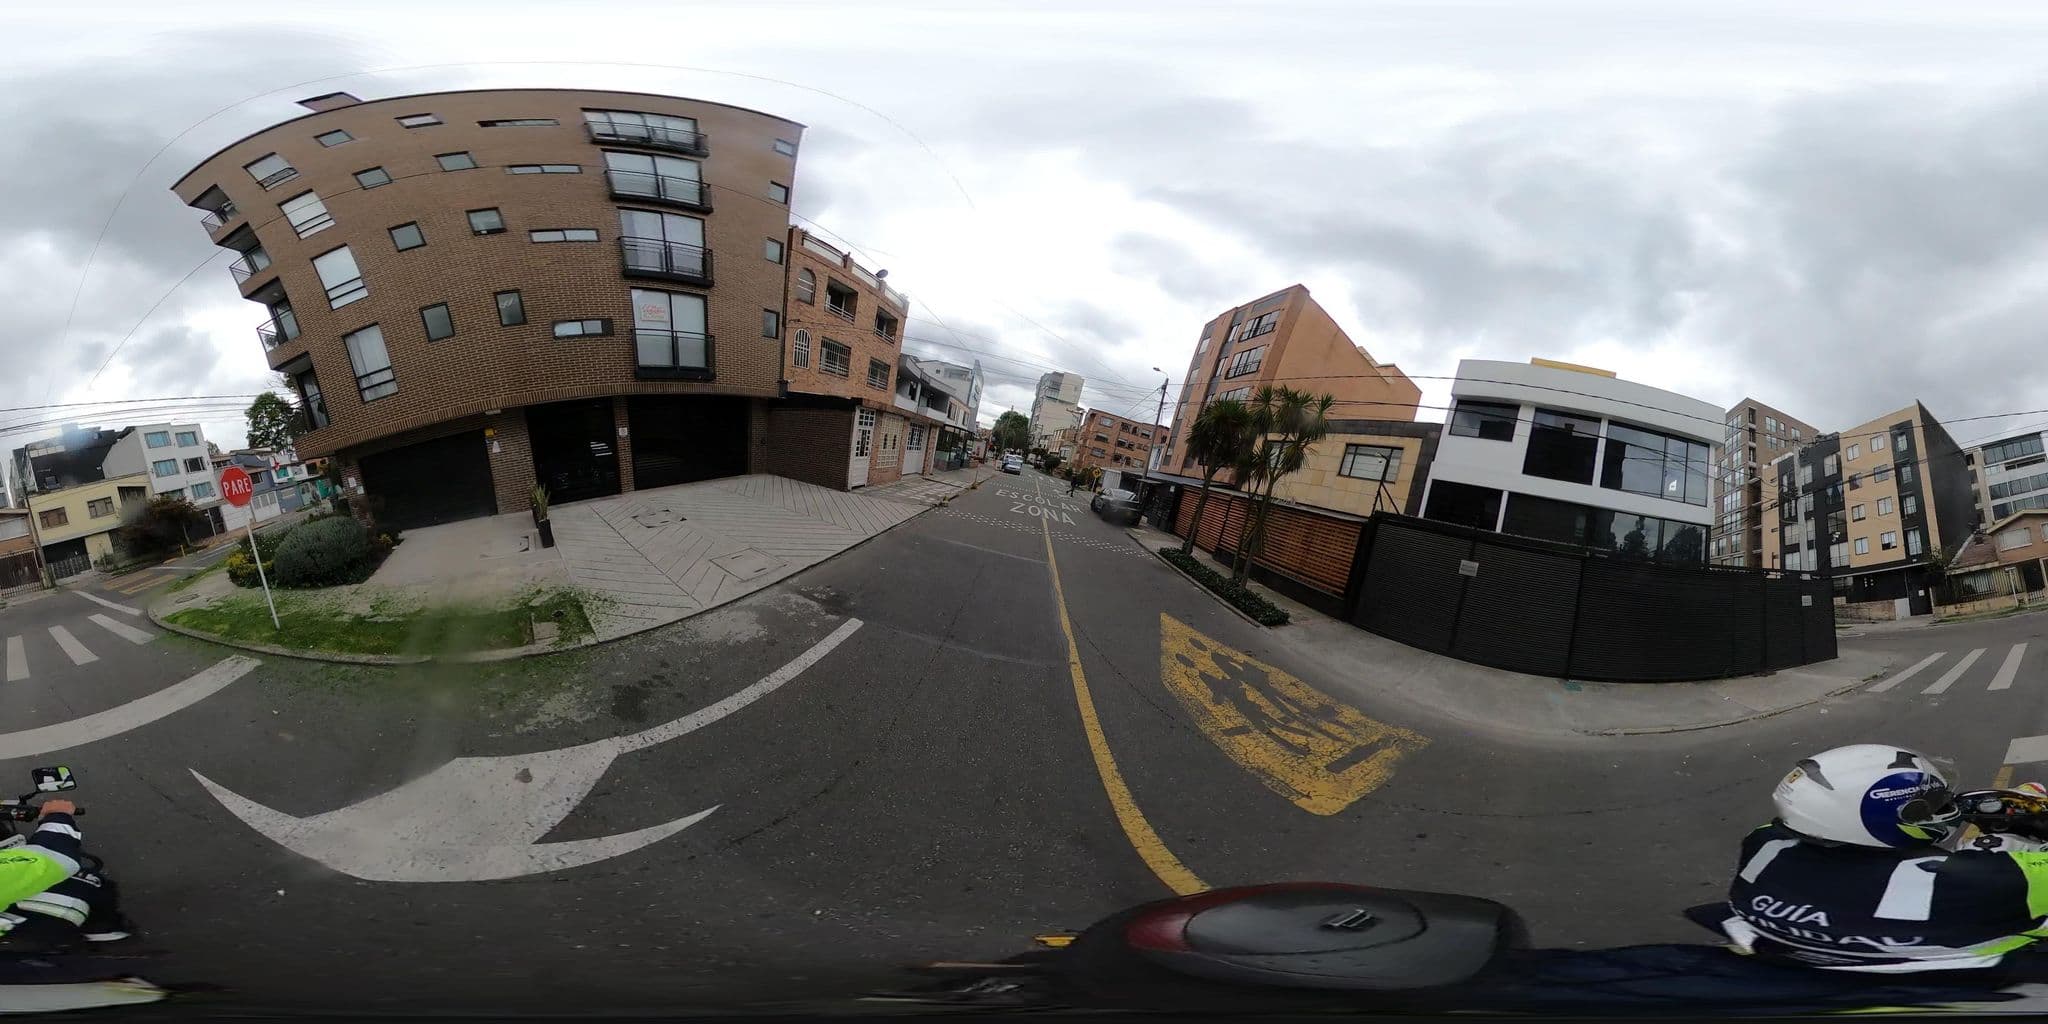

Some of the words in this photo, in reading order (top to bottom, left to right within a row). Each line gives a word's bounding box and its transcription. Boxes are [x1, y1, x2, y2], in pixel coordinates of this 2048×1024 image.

[222, 477, 251, 497] PARE
[995, 489, 1084, 514] ESCOLAR
[1009, 501, 1076, 526] ZONA
[1751, 895, 1831, 927] GUÍA
